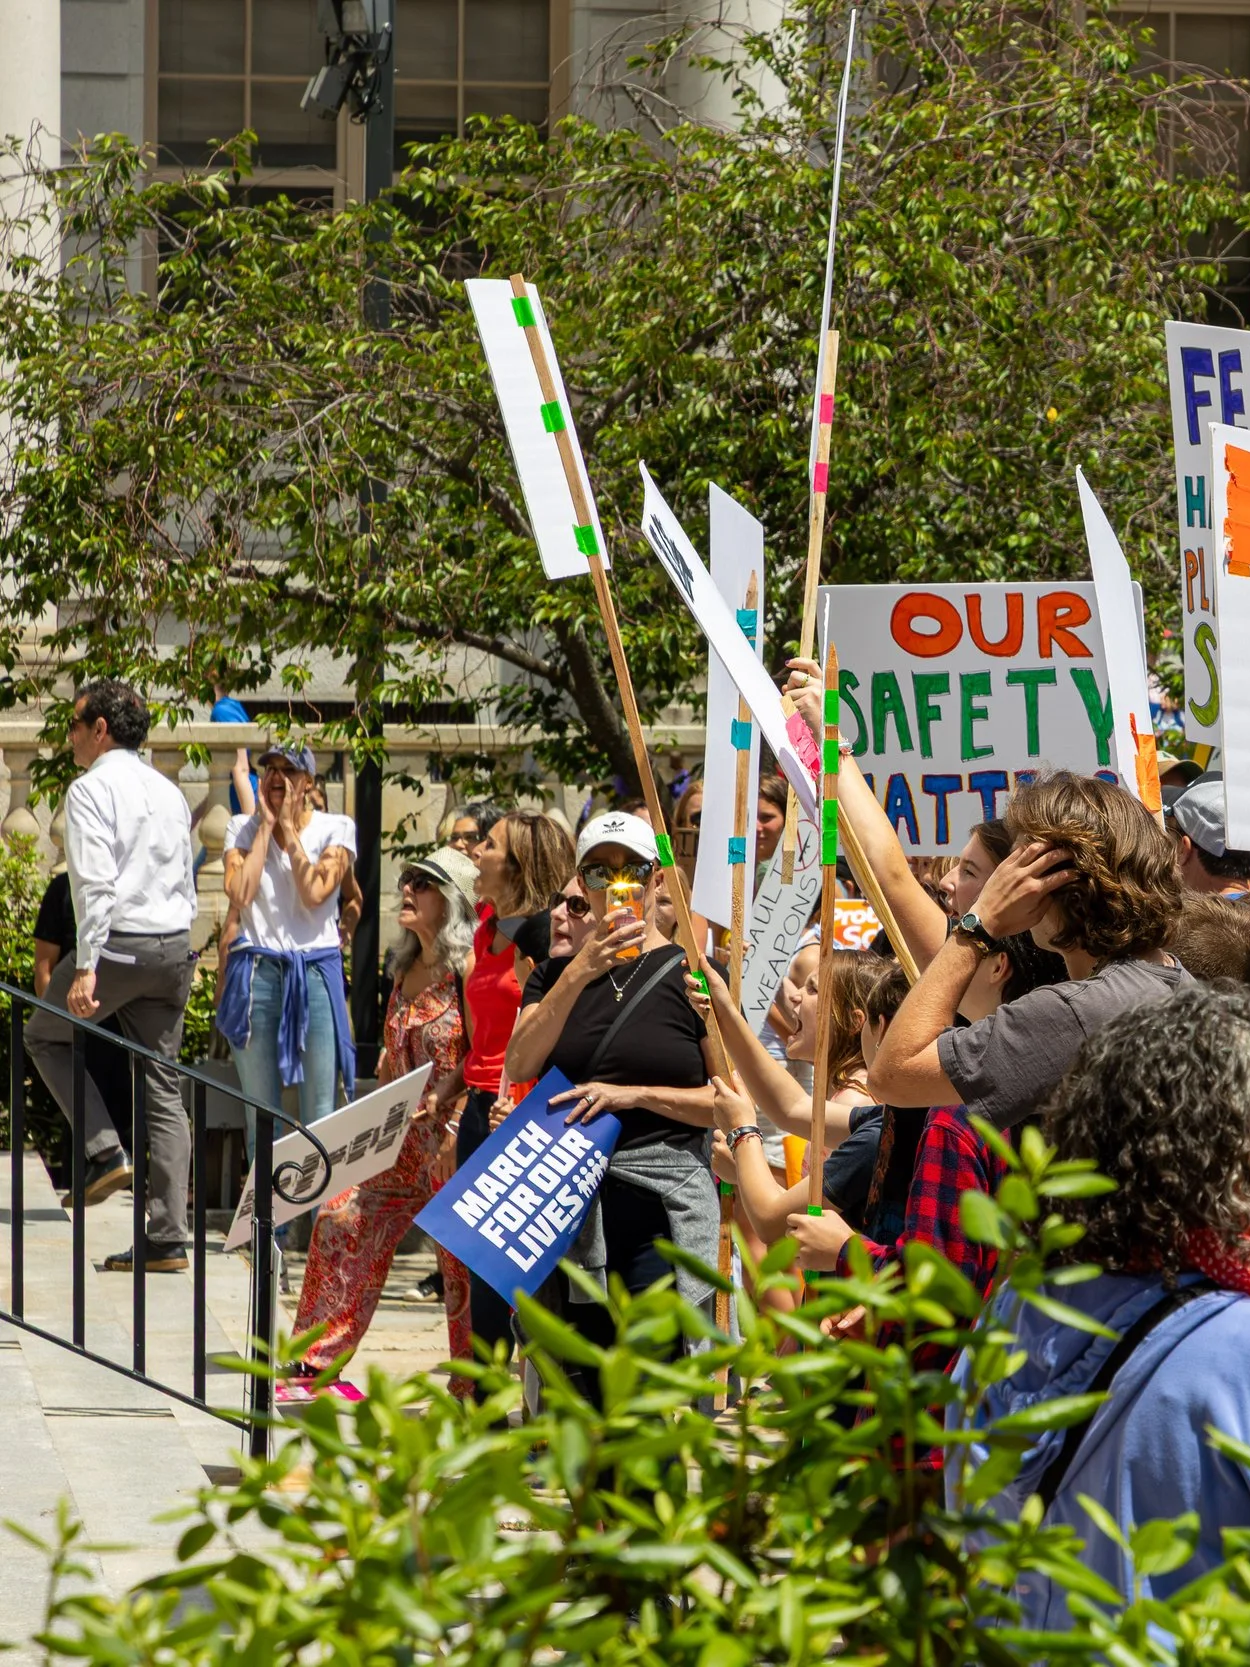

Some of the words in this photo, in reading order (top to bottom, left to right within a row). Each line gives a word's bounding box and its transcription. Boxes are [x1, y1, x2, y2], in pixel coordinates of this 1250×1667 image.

[890, 591, 1094, 658] OUR
[838, 666, 1114, 767] SAFETY
[741, 859, 783, 979] SSAULT
[750, 875, 818, 1012] WEAPONS
[452, 1119, 554, 1228] MARCH
[478, 1183, 545, 1249] FOR
[527, 1128, 594, 1195] OUR
[505, 1184, 585, 1274] LIVES
